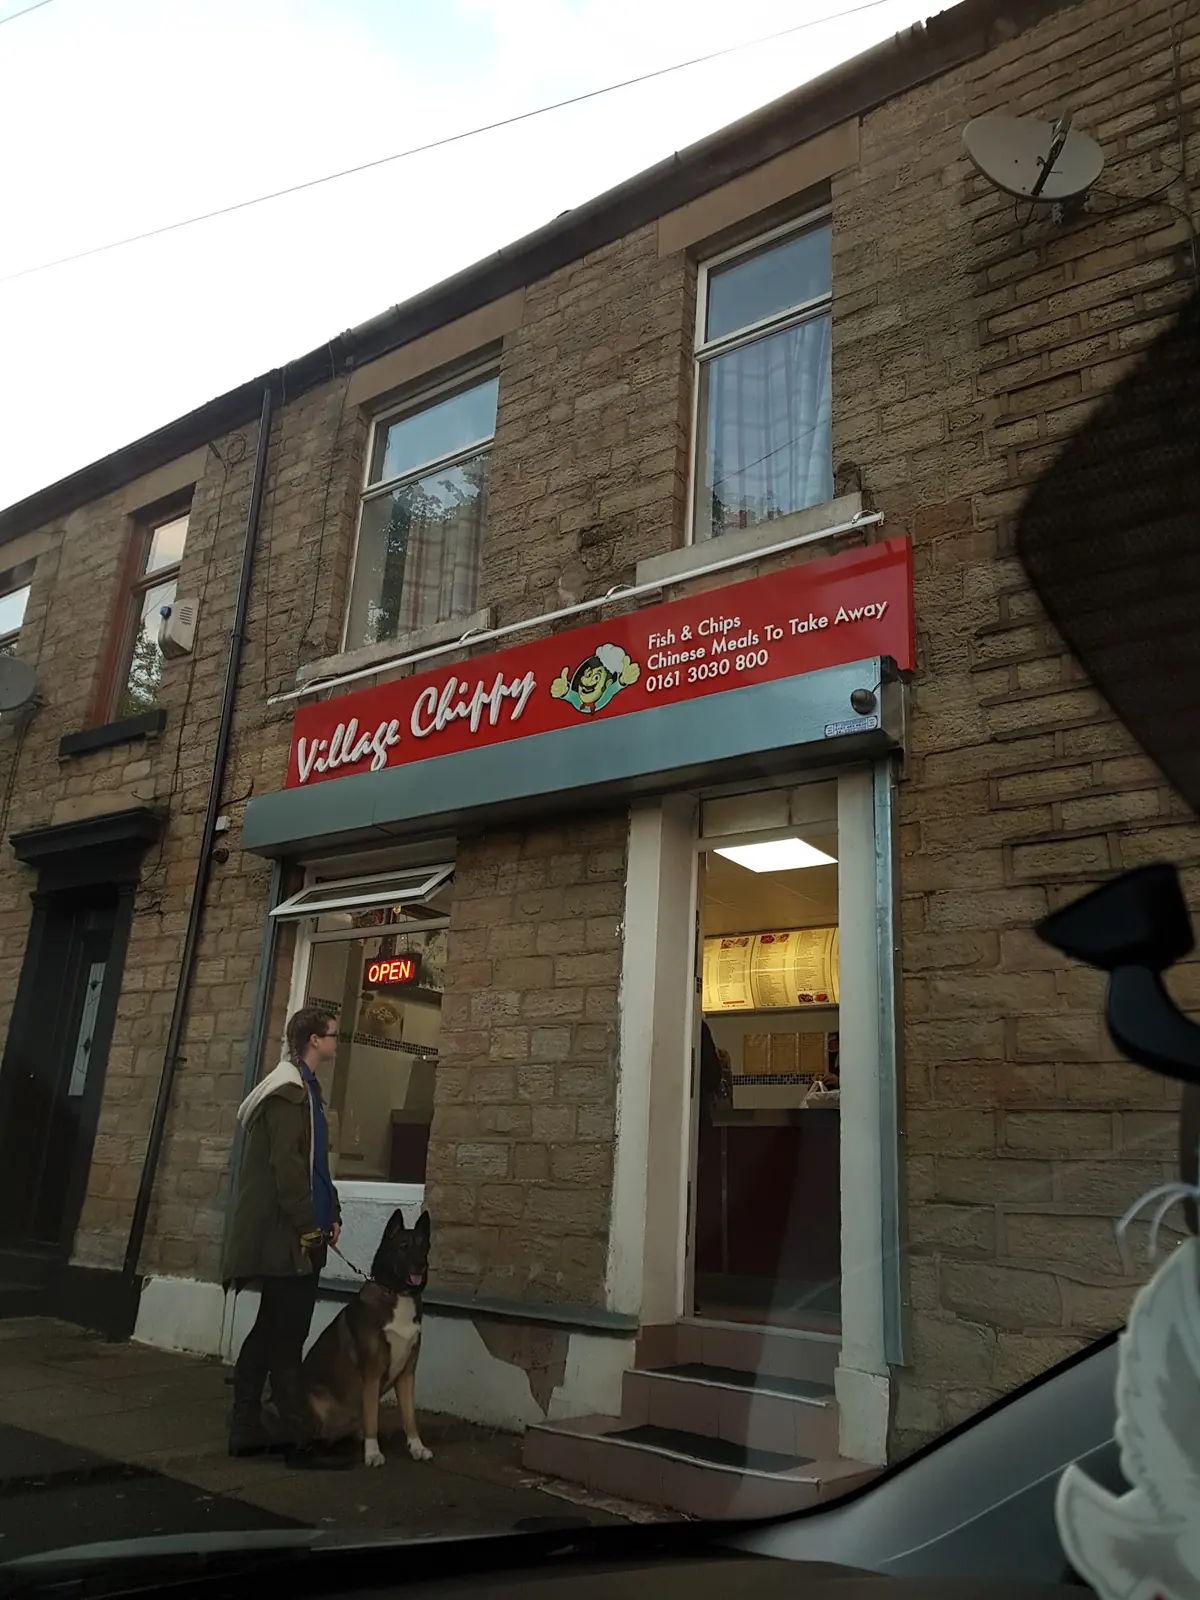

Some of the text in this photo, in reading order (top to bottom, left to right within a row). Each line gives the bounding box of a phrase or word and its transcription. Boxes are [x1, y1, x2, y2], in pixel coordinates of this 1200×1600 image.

[647, 601, 888, 671] Chinese Meals To Take Away
[648, 615, 741, 649] Fish & Chips
[646, 649, 769, 692] 0161 3030 800
[297, 671, 536, 783] Village Chippy
[368, 961, 411, 982] OPEN
